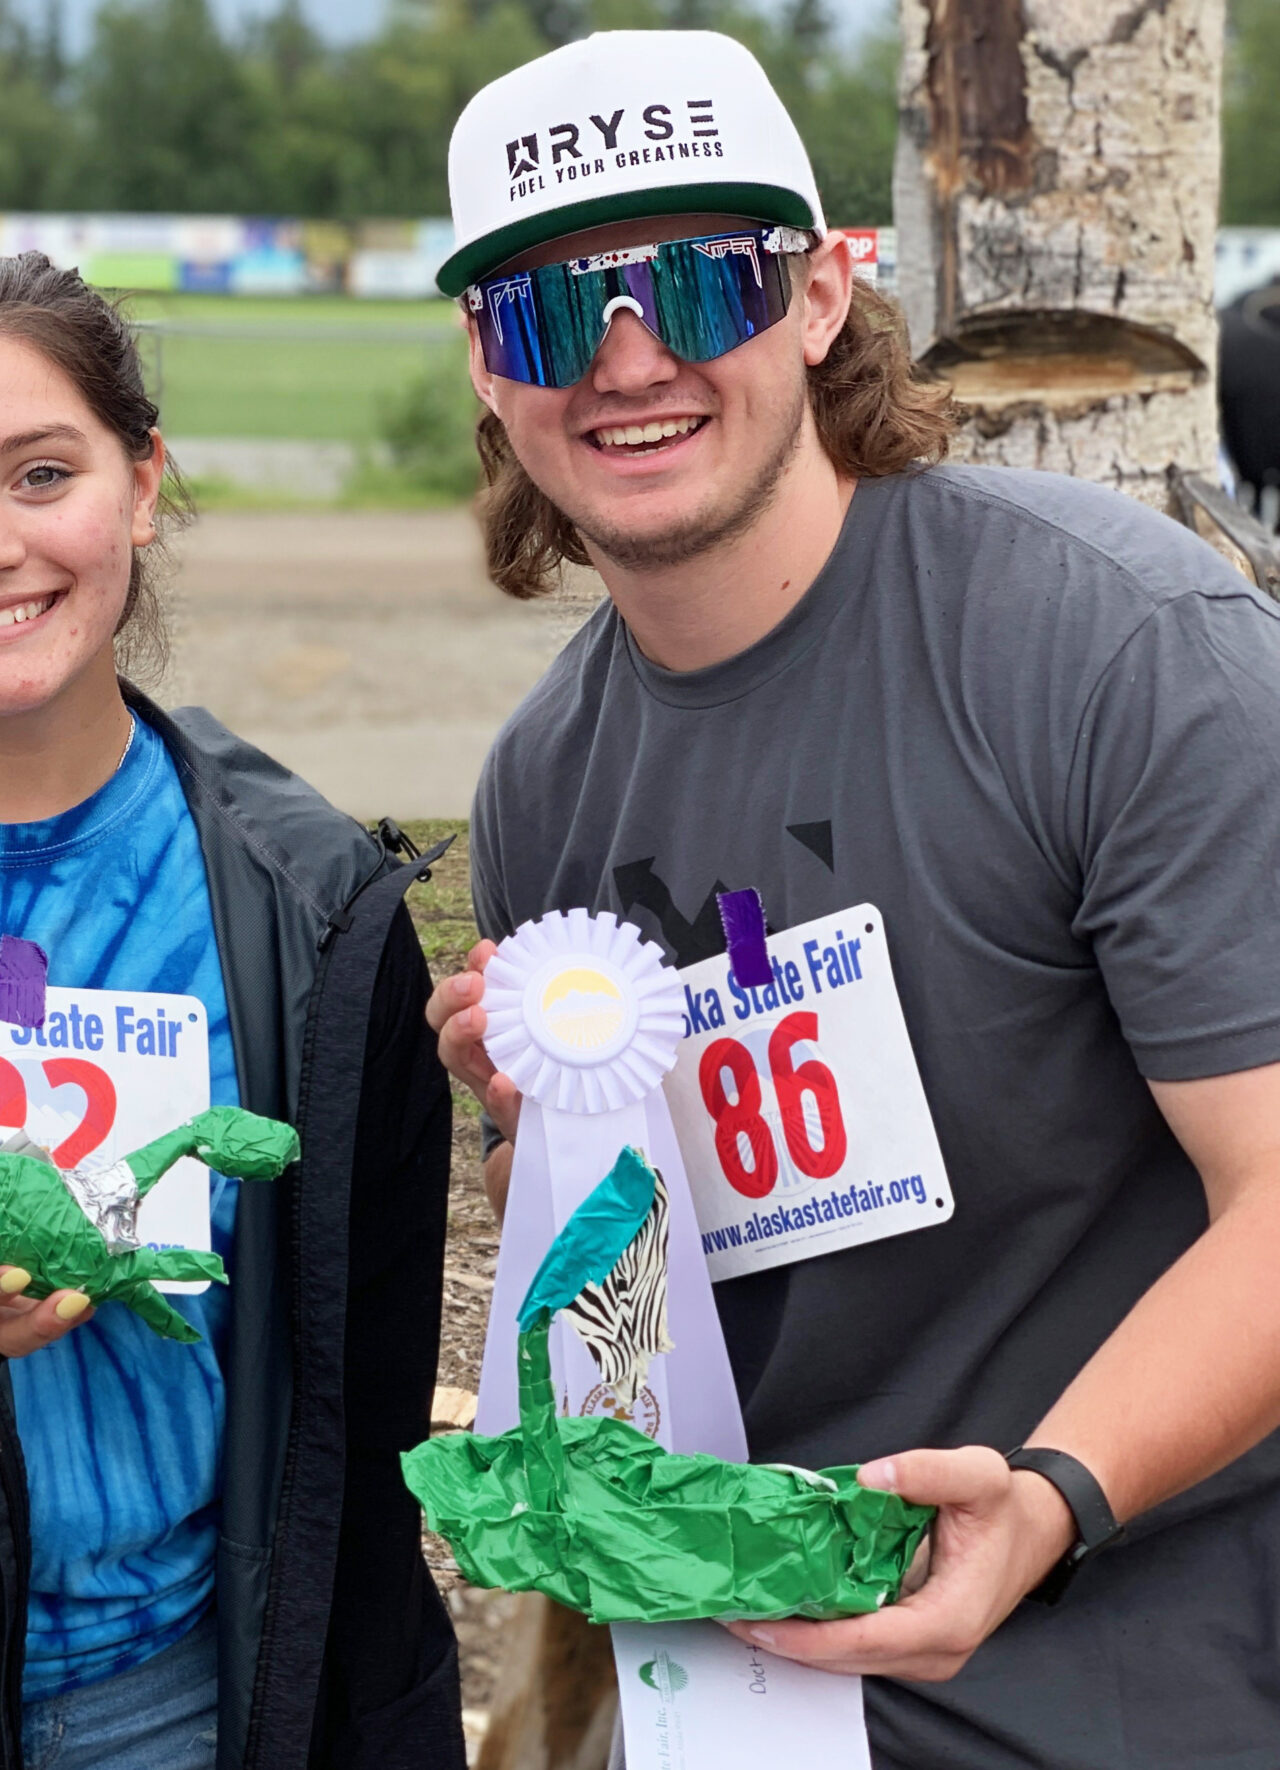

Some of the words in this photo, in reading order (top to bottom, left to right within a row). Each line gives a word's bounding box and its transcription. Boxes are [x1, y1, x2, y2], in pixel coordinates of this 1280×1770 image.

[549, 100, 718, 164] RYSE
[510, 175, 545, 201] FUEL
[555, 159, 605, 183] YOUR
[615, 141, 724, 168] GREATNESS
[803, 930, 863, 994] Fair
[115, 1005, 182, 1058] Fair
[699, 1011, 847, 1200] 86
[701, 1174, 927, 1255] www.alaskastatefair.org
[749, 1657, 766, 1694] Duct
[655, 1706, 668, 1728] Inc.
